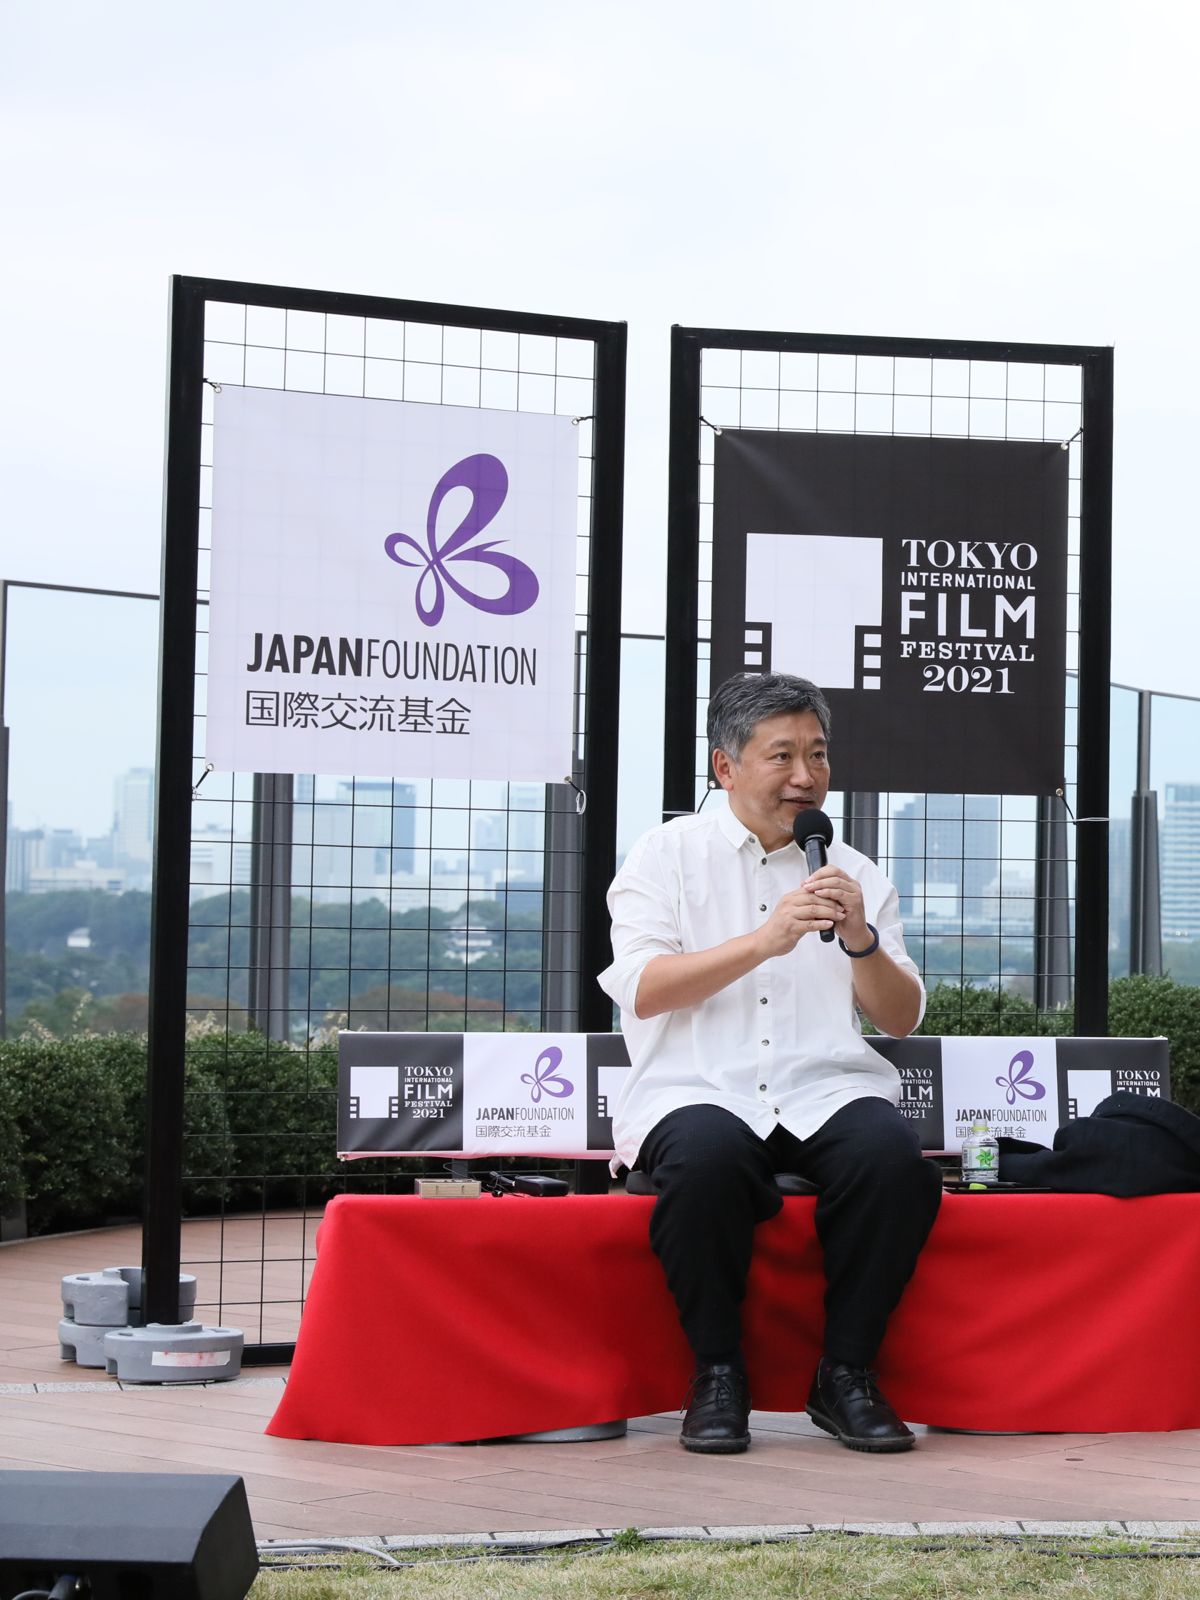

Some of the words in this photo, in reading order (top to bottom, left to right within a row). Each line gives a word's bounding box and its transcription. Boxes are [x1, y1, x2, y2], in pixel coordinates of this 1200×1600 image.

[902, 539, 1038, 570] TOKYO
[901, 572, 1036, 590] INTERNATIONAL
[900, 592, 1036, 639] FILM
[900, 642, 1035, 662] FESTIVAL
[923, 665, 1015, 694] 2021
[245, 690, 471, 735] 国際交流基金
[404, 1066, 453, 1077] TOKYO
[898, 1068, 933, 1078] OKYO
[1116, 1070, 1160, 1080] TOKYO
[404, 1084, 453, 1100] FILM
[900, 1085, 933, 1100] ILM
[404, 1100, 453, 1108] FESTIVAL
[412, 1108, 445, 1119] 2021
[476, 1125, 552, 1138] 国際交流基金
